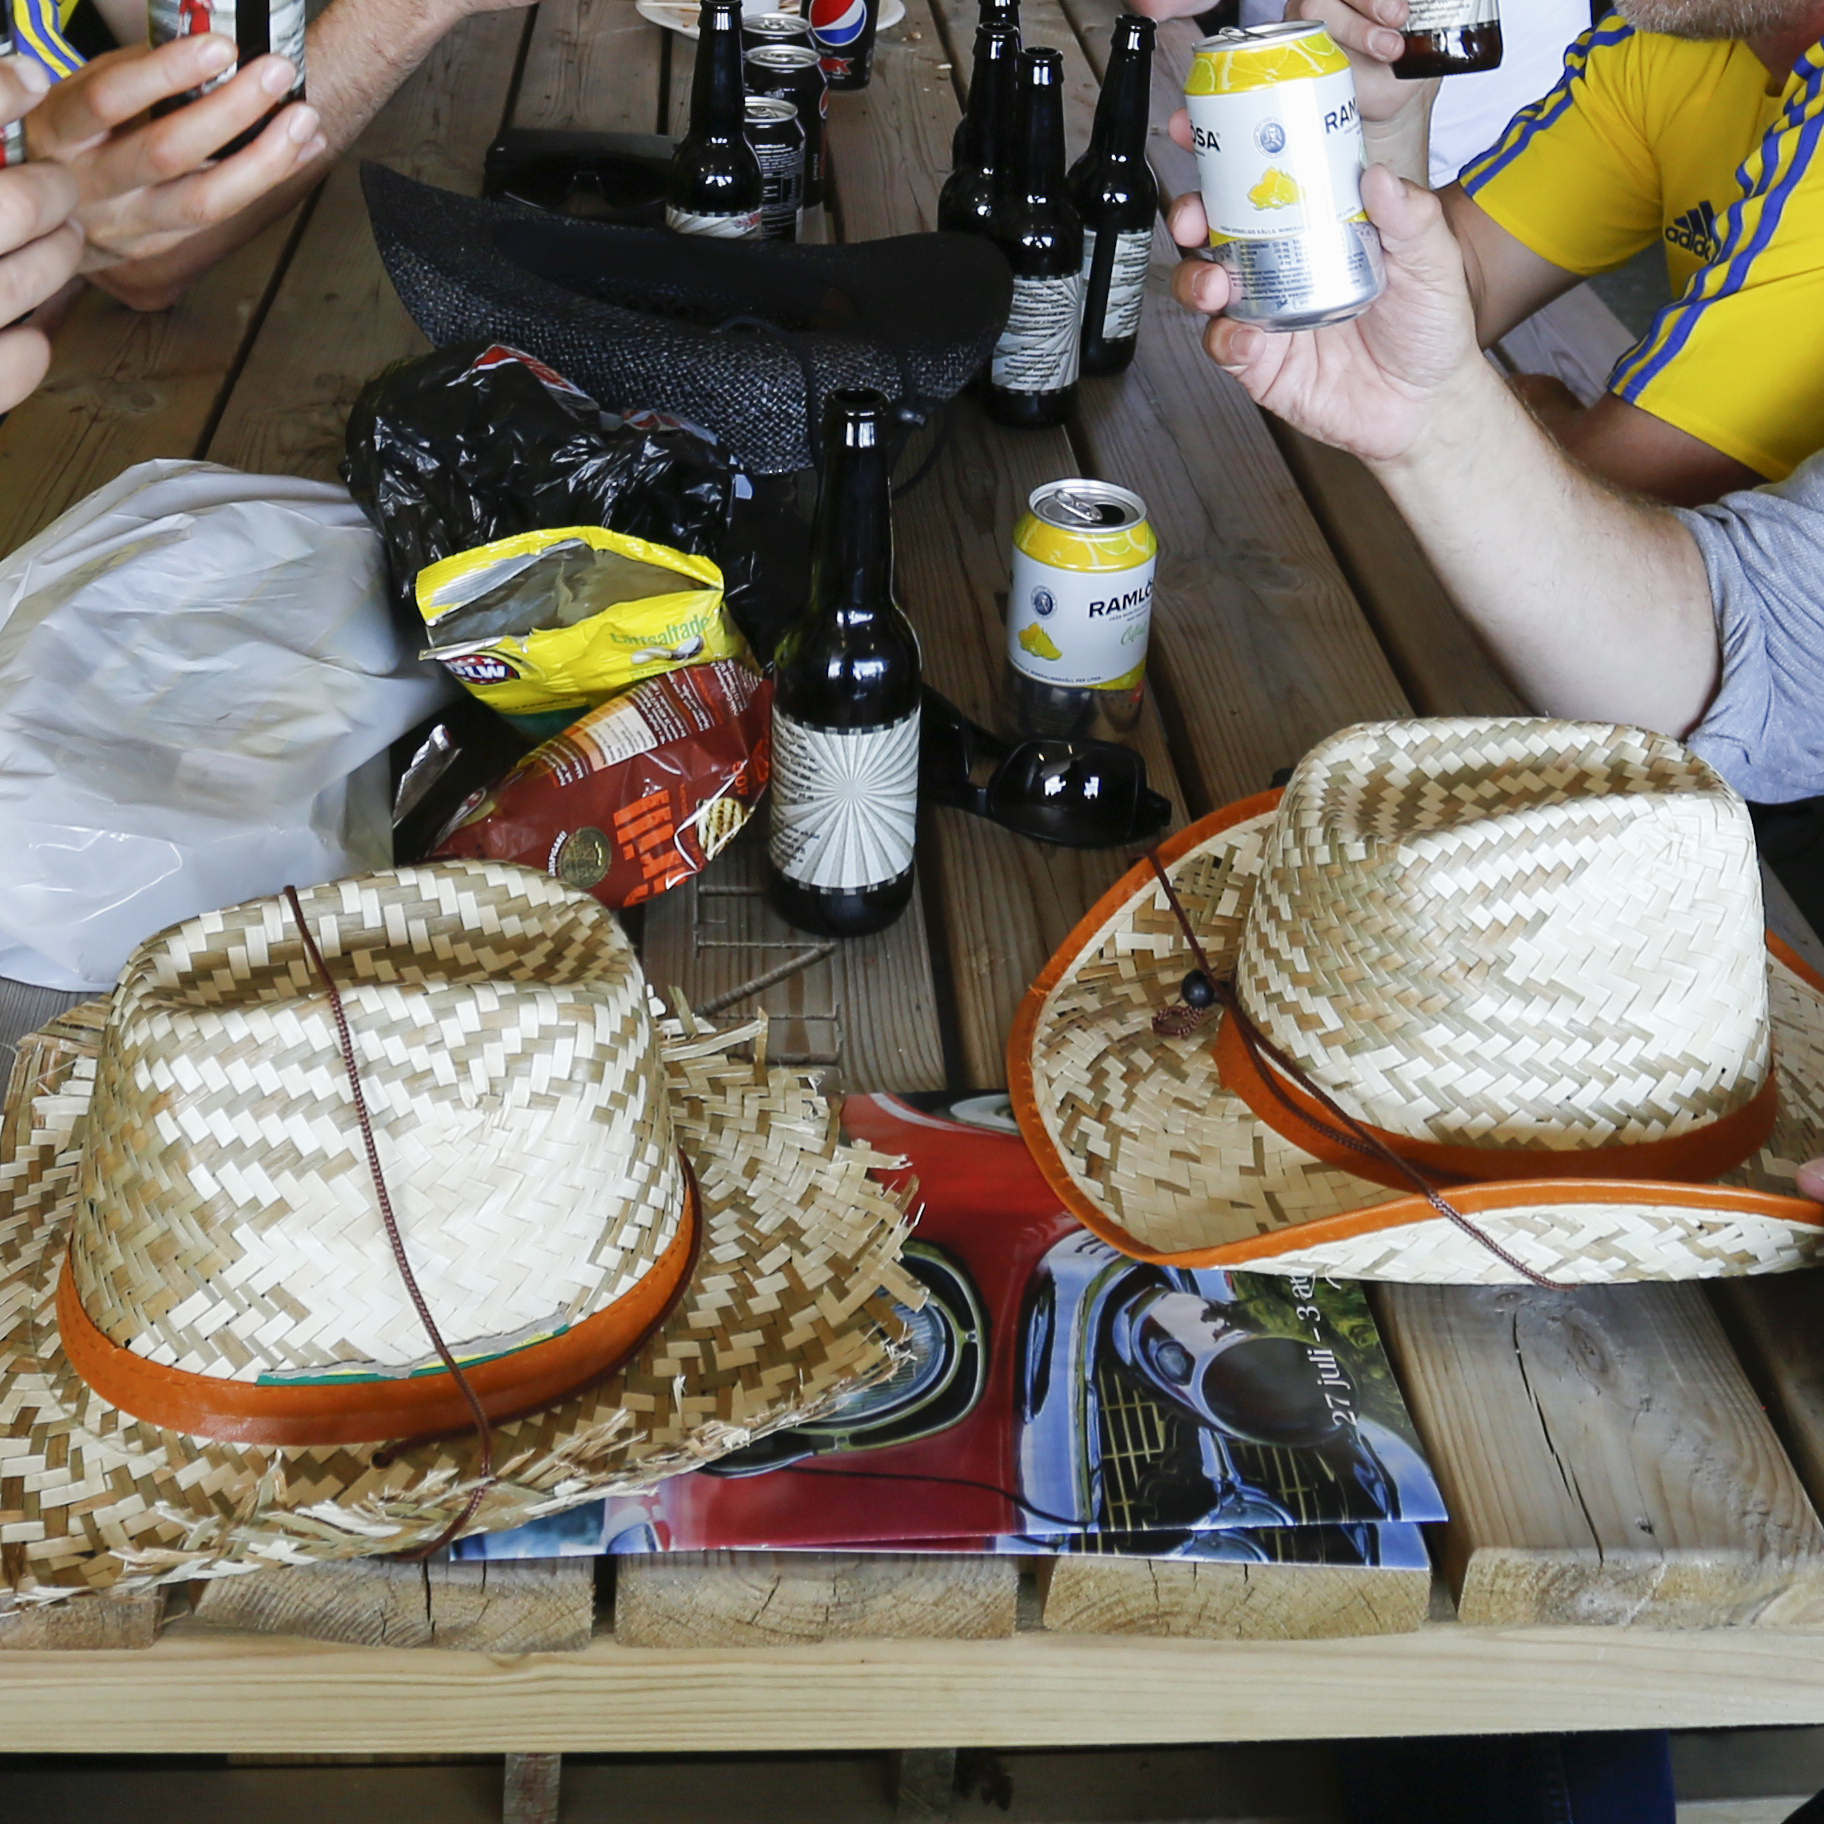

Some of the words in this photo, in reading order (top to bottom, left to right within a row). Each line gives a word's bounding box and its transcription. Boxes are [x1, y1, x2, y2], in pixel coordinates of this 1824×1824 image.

[1296, 1305, 1321, 1322] 3
[1307, 1348, 1351, 1390] juli
[1331, 1393, 1358, 1427] 27
